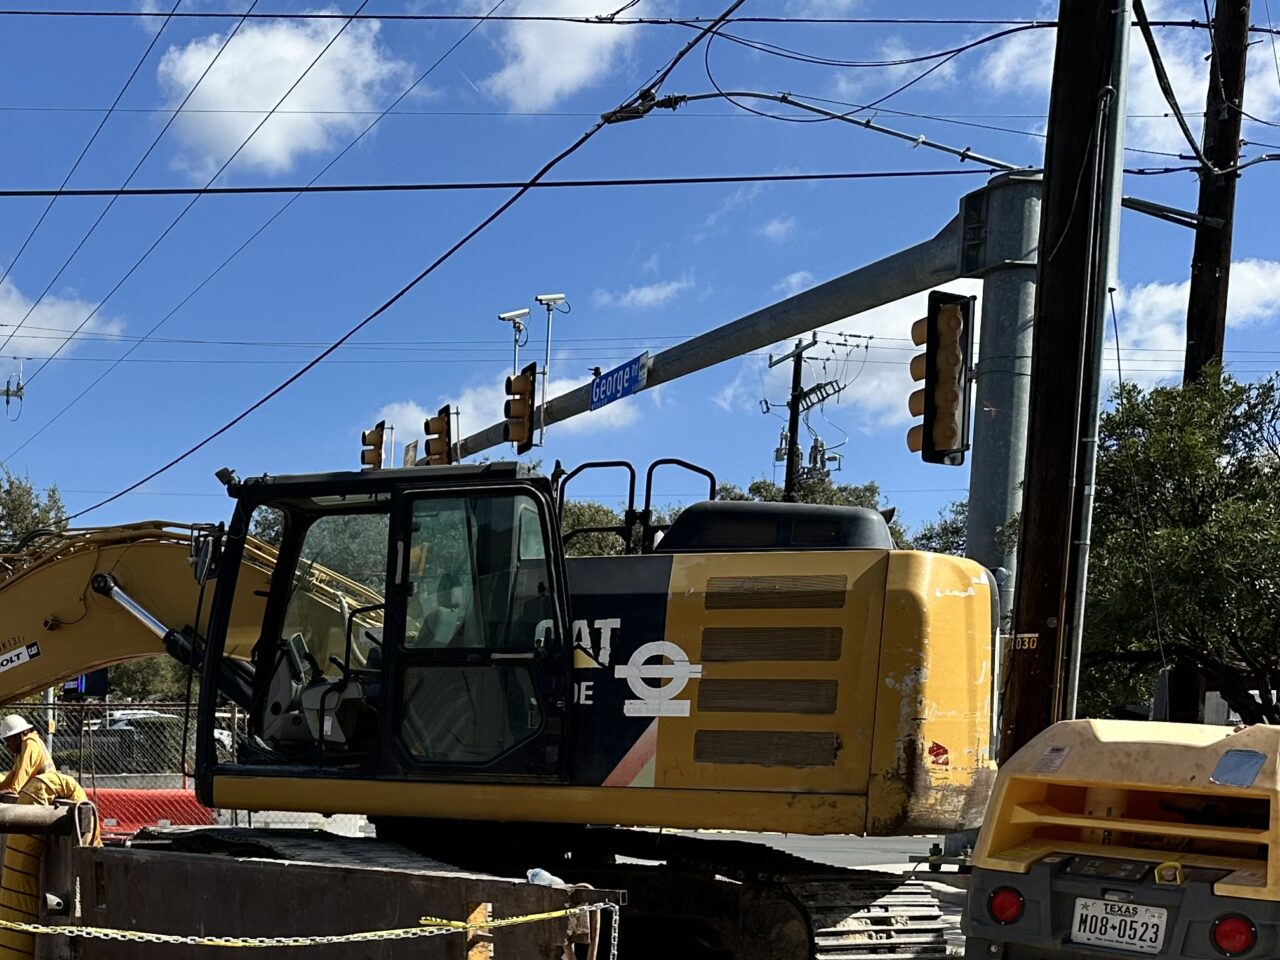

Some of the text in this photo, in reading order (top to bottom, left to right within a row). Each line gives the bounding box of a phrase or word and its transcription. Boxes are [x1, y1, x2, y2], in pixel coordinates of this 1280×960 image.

[592, 366, 630, 402] George
[28, 646, 38, 655] CAT
[1103, 902, 1138, 916] TEXAS
